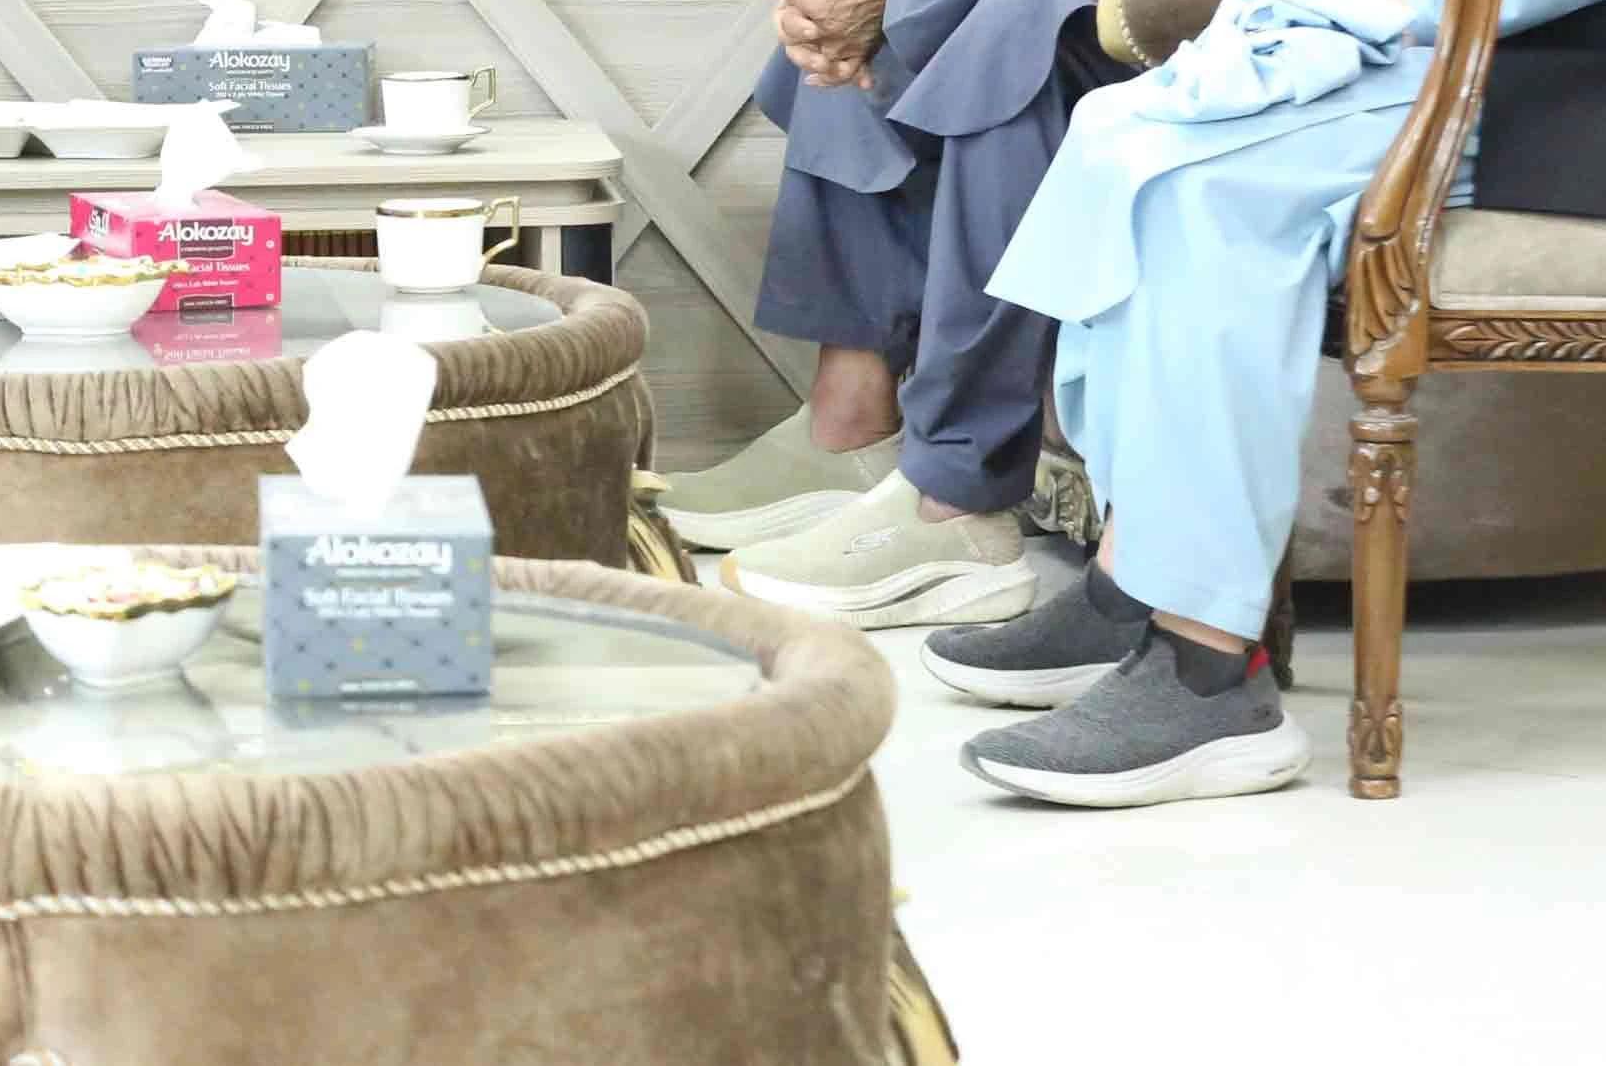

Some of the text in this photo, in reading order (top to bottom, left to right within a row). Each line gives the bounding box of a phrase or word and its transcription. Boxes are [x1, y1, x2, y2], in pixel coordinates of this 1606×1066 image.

[209, 51, 291, 71] Alokozay
[208, 81, 292, 91] Soft Facial Tissues
[158, 222, 254, 246] Alokozay
[216, 261, 250, 272] Tissues
[305, 534, 453, 575] Alokozay
